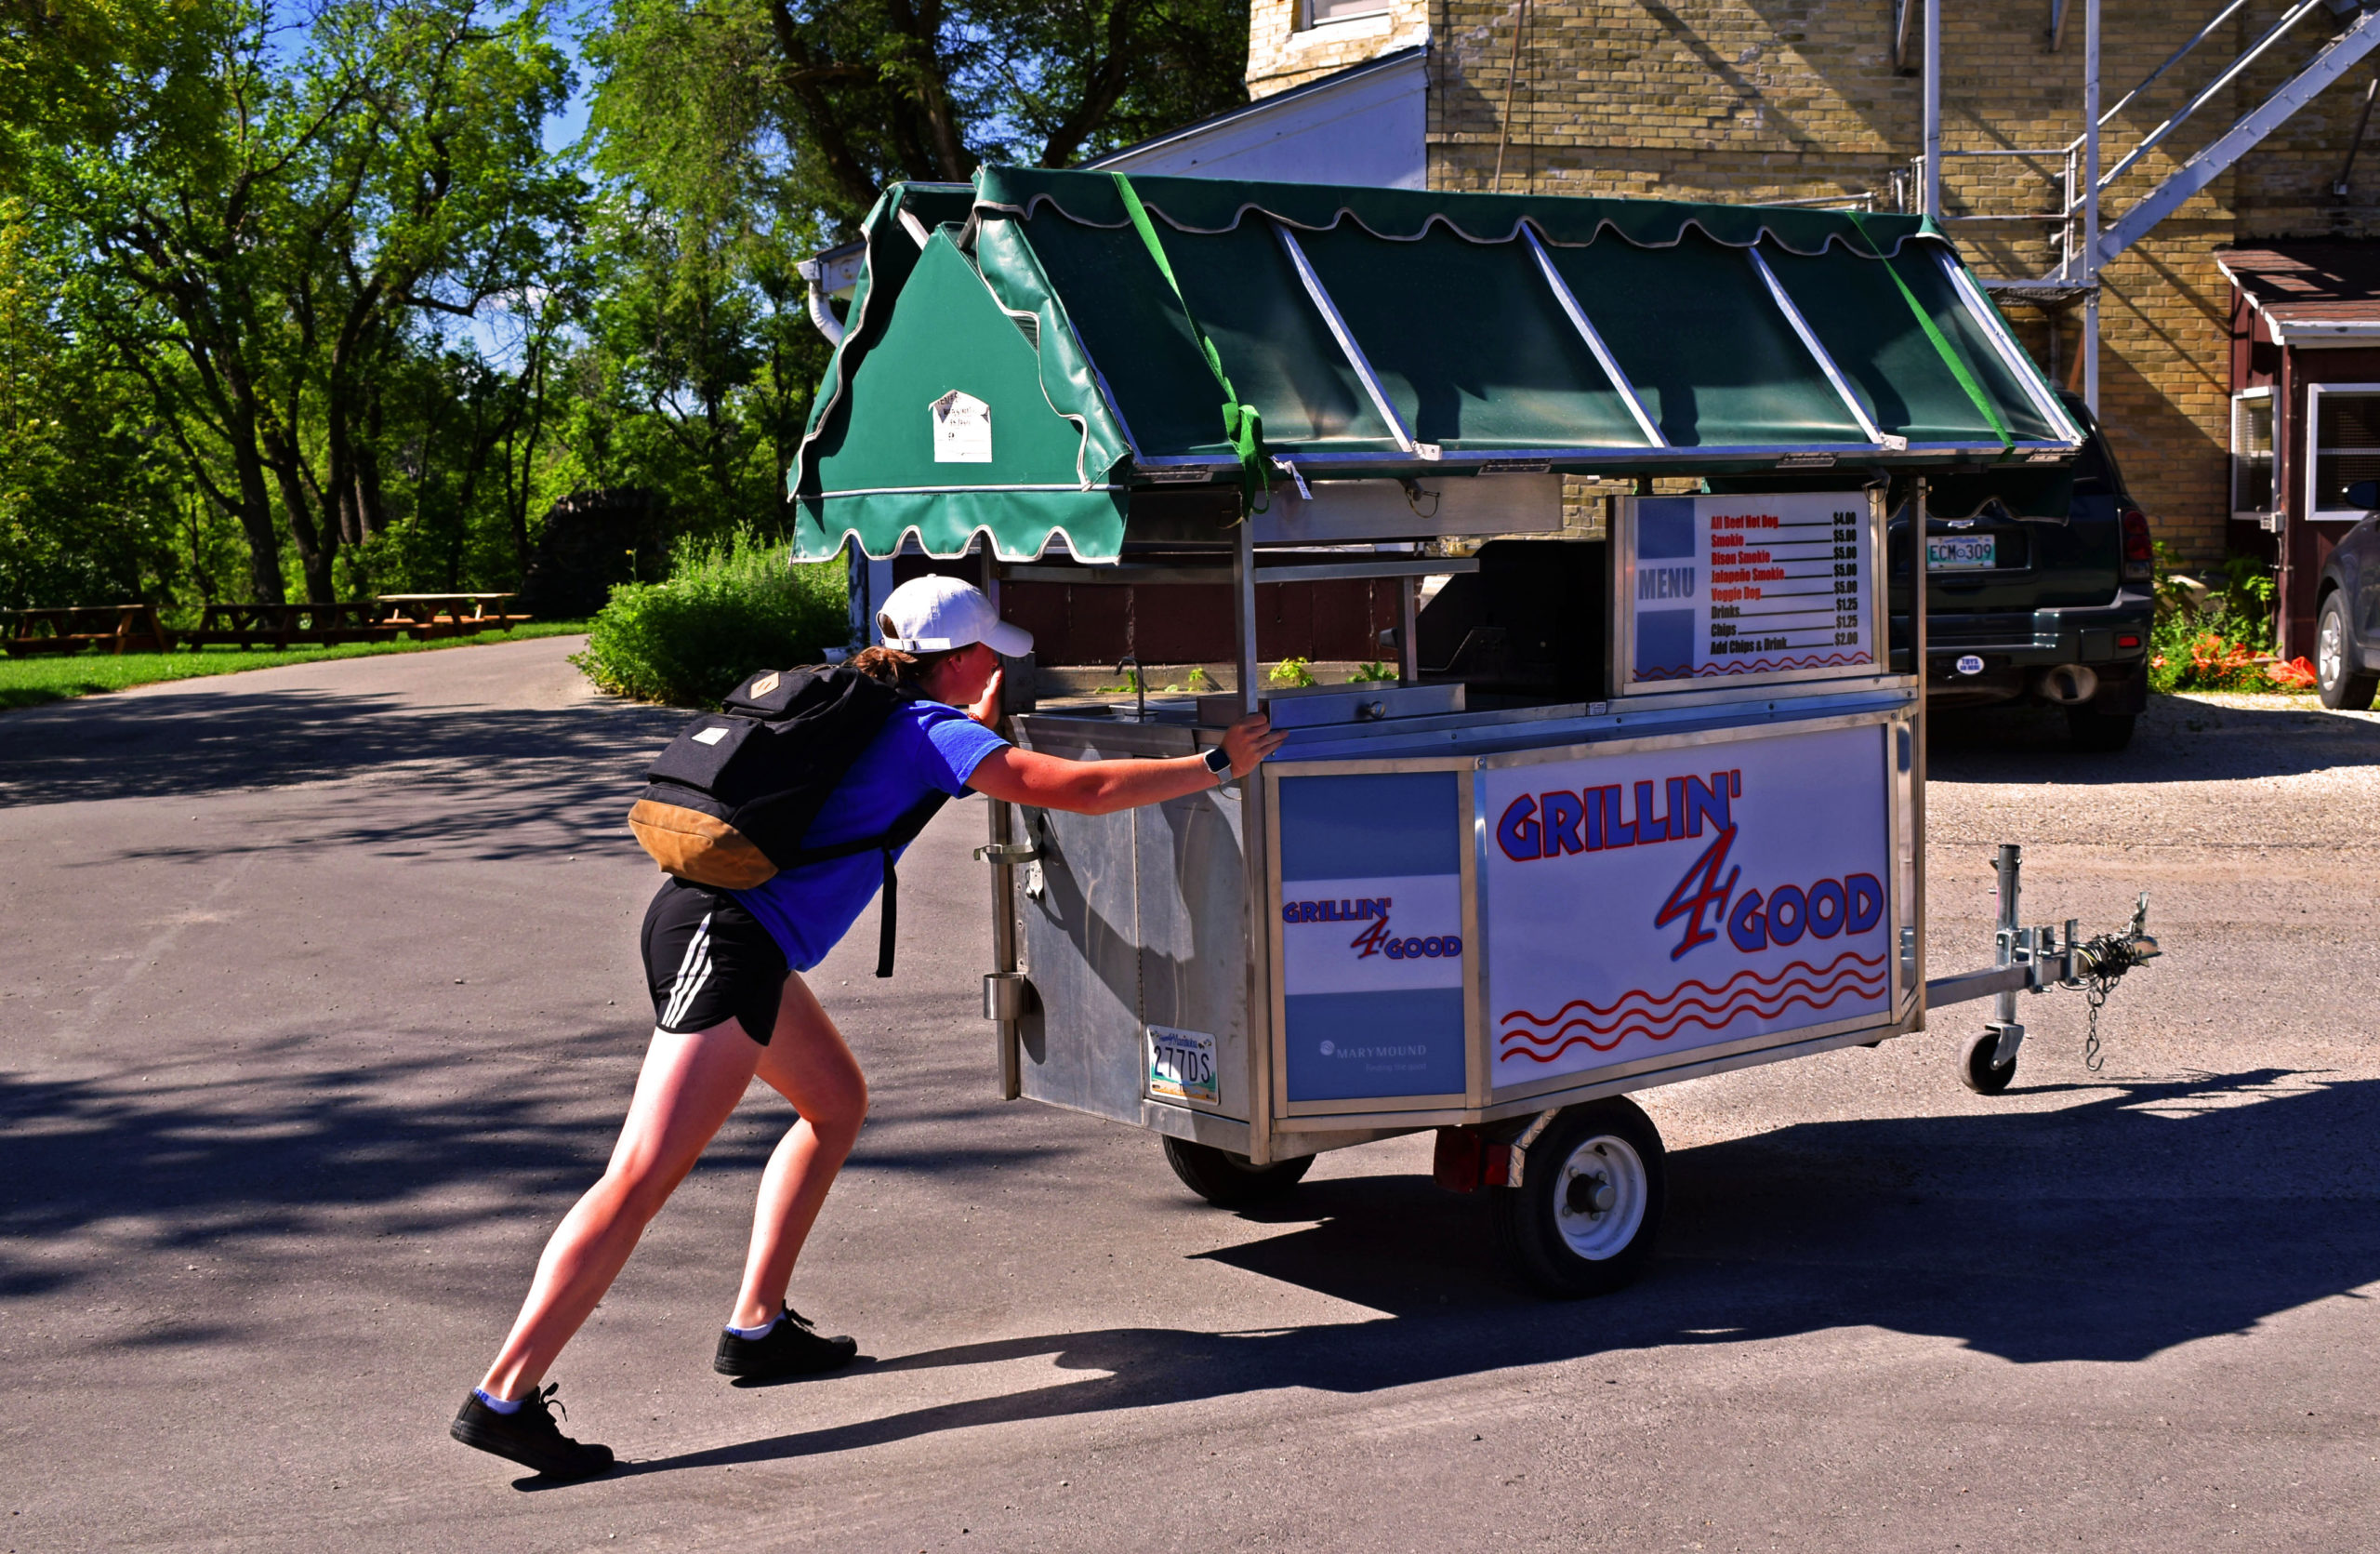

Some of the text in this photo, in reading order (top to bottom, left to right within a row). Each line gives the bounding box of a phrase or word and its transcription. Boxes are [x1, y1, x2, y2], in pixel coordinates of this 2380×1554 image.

[1711, 513, 1778, 530] All Beef Hot Dog
[1832, 511, 1857, 526] $4.00
[1711, 533, 1744, 548] Smokie
[1833, 528, 1858, 543] $5.00
[1712, 550, 1771, 565] Bison Smokie
[1833, 546, 1858, 560] $5.00
[1930, 544, 1992, 561] ECM 309
[1711, 566, 1785, 584] Jalapeño Smokie
[1833, 564, 1858, 578] $5.00
[1638, 567, 1696, 600] MENU
[1834, 580, 1858, 595] $5.00
[1711, 586, 1761, 603] Veggie Dog
[1711, 604, 1740, 619] Drinks
[1836, 598, 1858, 612] $1.25
[1711, 623, 1737, 637] Chips
[1836, 615, 1858, 630] $1.25
[1711, 637, 1787, 655] Add Chips & Drink
[1834, 631, 1858, 646] $2.00
[1497, 769, 1741, 862] GRILLIN'
[1654, 822, 1884, 962] 4 GOOD
[1282, 897, 1392, 923] GRILLIN'
[1351, 915, 1463, 960] 4 GOOD
[1336, 1044, 1427, 1058] MARYMOUND
[1154, 1045, 1210, 1083] 277DS
